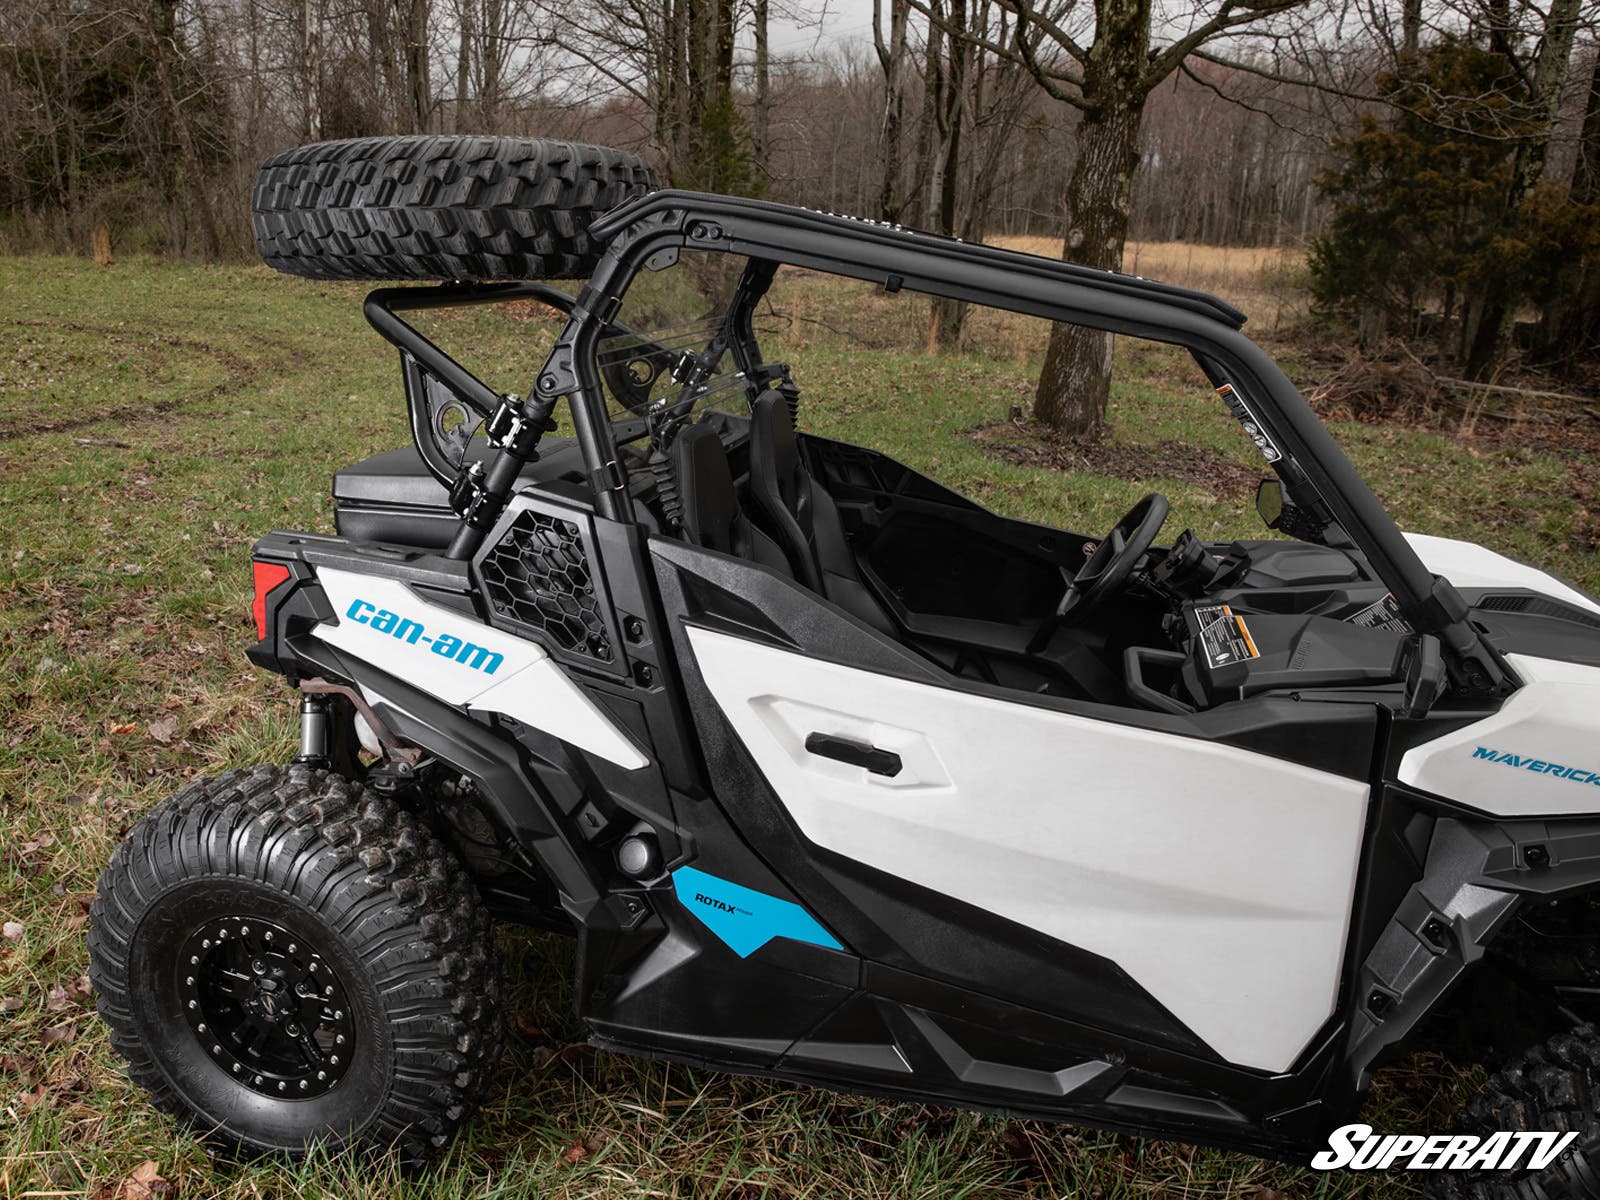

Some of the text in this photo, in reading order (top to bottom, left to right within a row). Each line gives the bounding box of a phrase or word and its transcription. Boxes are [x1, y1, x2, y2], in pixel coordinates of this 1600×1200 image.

[346, 600, 504, 675] can-am
[1472, 746, 1600, 787] MAVERICK
[695, 893, 736, 914] ROTAX
